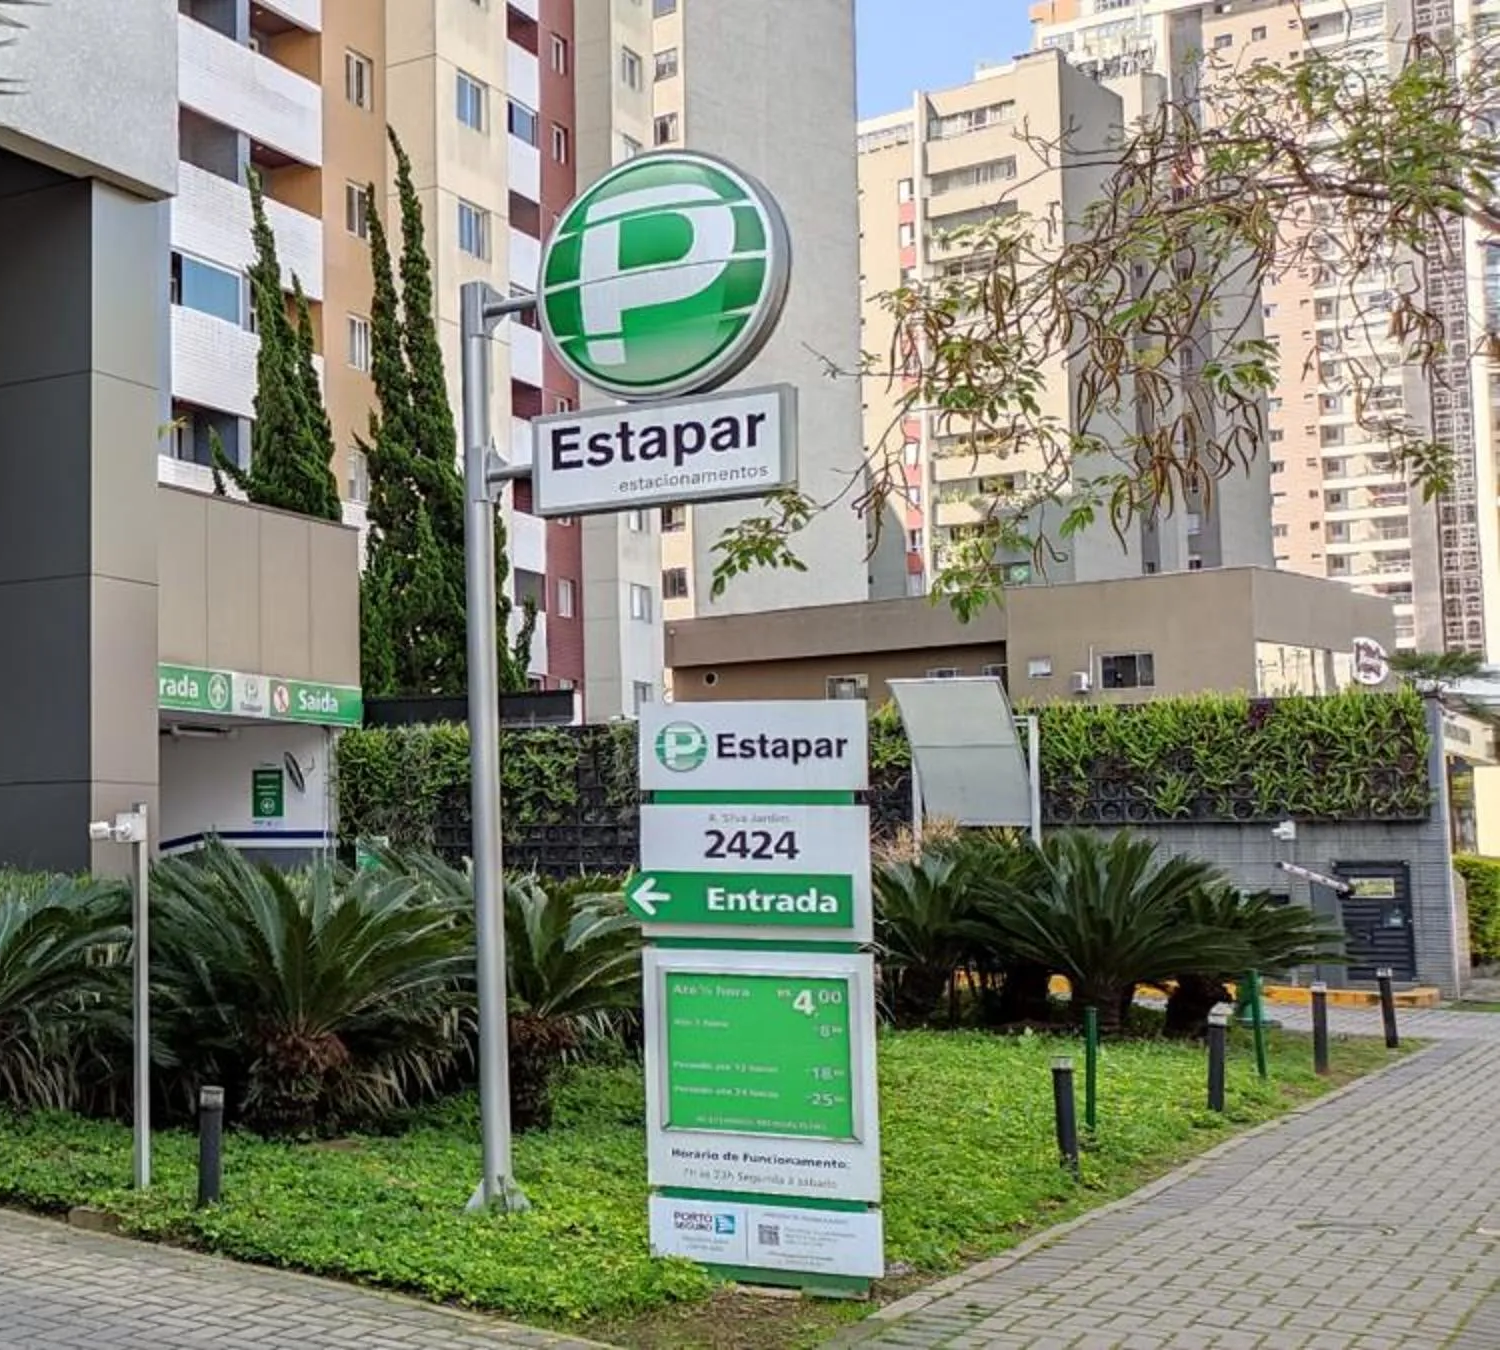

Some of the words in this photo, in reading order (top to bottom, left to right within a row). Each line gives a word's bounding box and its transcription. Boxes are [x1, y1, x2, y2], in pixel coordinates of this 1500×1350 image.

[579, 183, 736, 366] P
[551, 411, 766, 471] Estapar
[618, 464, 769, 494] estacionamentos
[298, 689, 338, 713] Saída
[716, 733, 848, 765] Estapar
[704, 829, 800, 860] 2424
[707, 887, 838, 914] Entrada
[723, 1151, 739, 1162] de
[673, 1211, 712, 1222] PORTO
[674, 1221, 712, 1233] SEGURO
